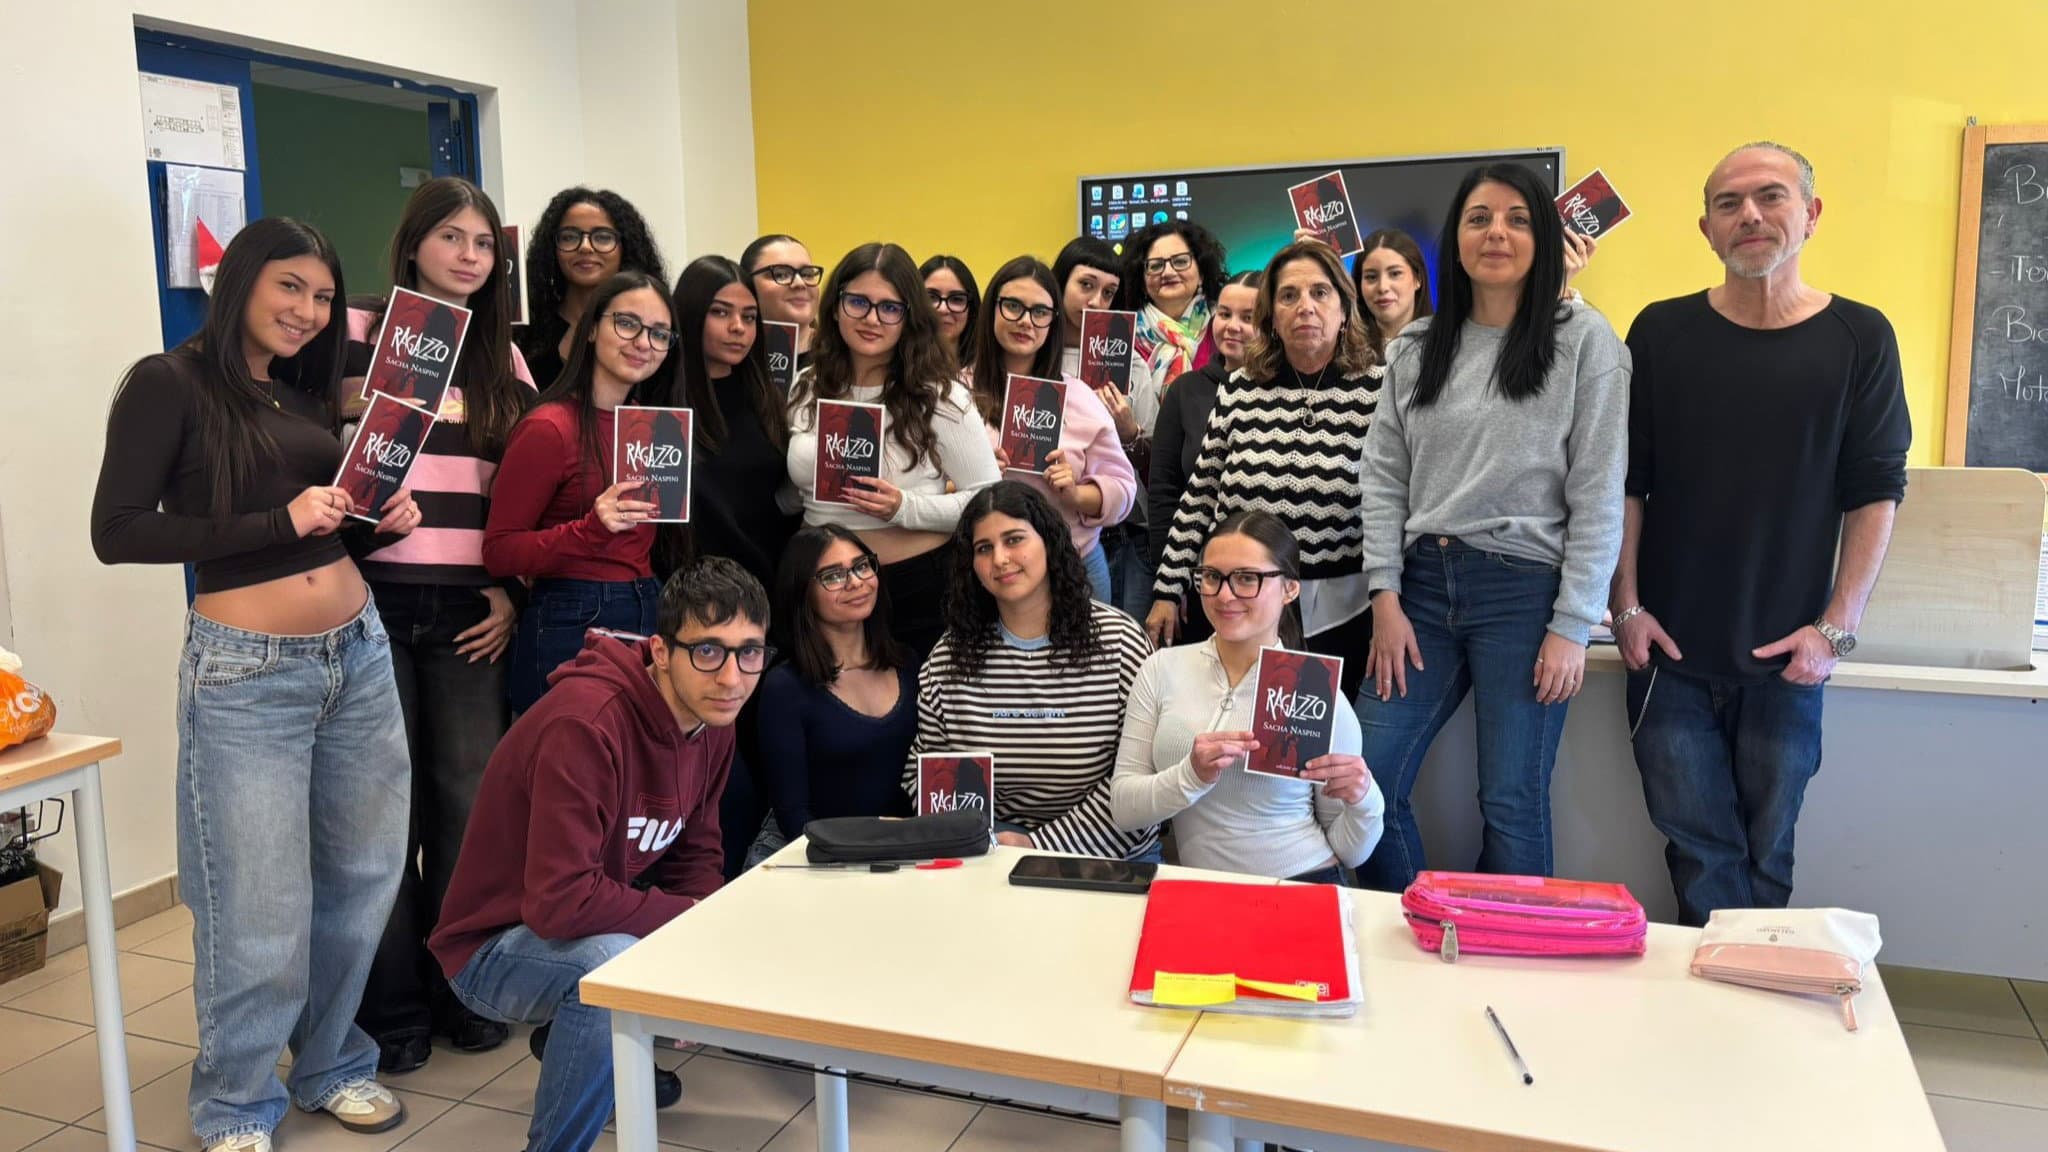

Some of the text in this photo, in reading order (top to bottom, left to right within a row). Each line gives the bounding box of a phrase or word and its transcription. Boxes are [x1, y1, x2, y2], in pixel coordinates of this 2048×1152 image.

[1303, 200, 1344, 229] RAGAZZO
[1563, 192, 1600, 234] RAGAZZO
[391, 326, 450, 362] RAGAZZO
[1089, 334, 1128, 359] RAGAZZO
[1012, 403, 1057, 430] RAGAZZO
[362, 432, 411, 468] RAGAZZO
[625, 439, 682, 472] RAGAZZO
[825, 431, 875, 461] RAGAZZO
[1265, 685, 1327, 720] RAGAZZO
